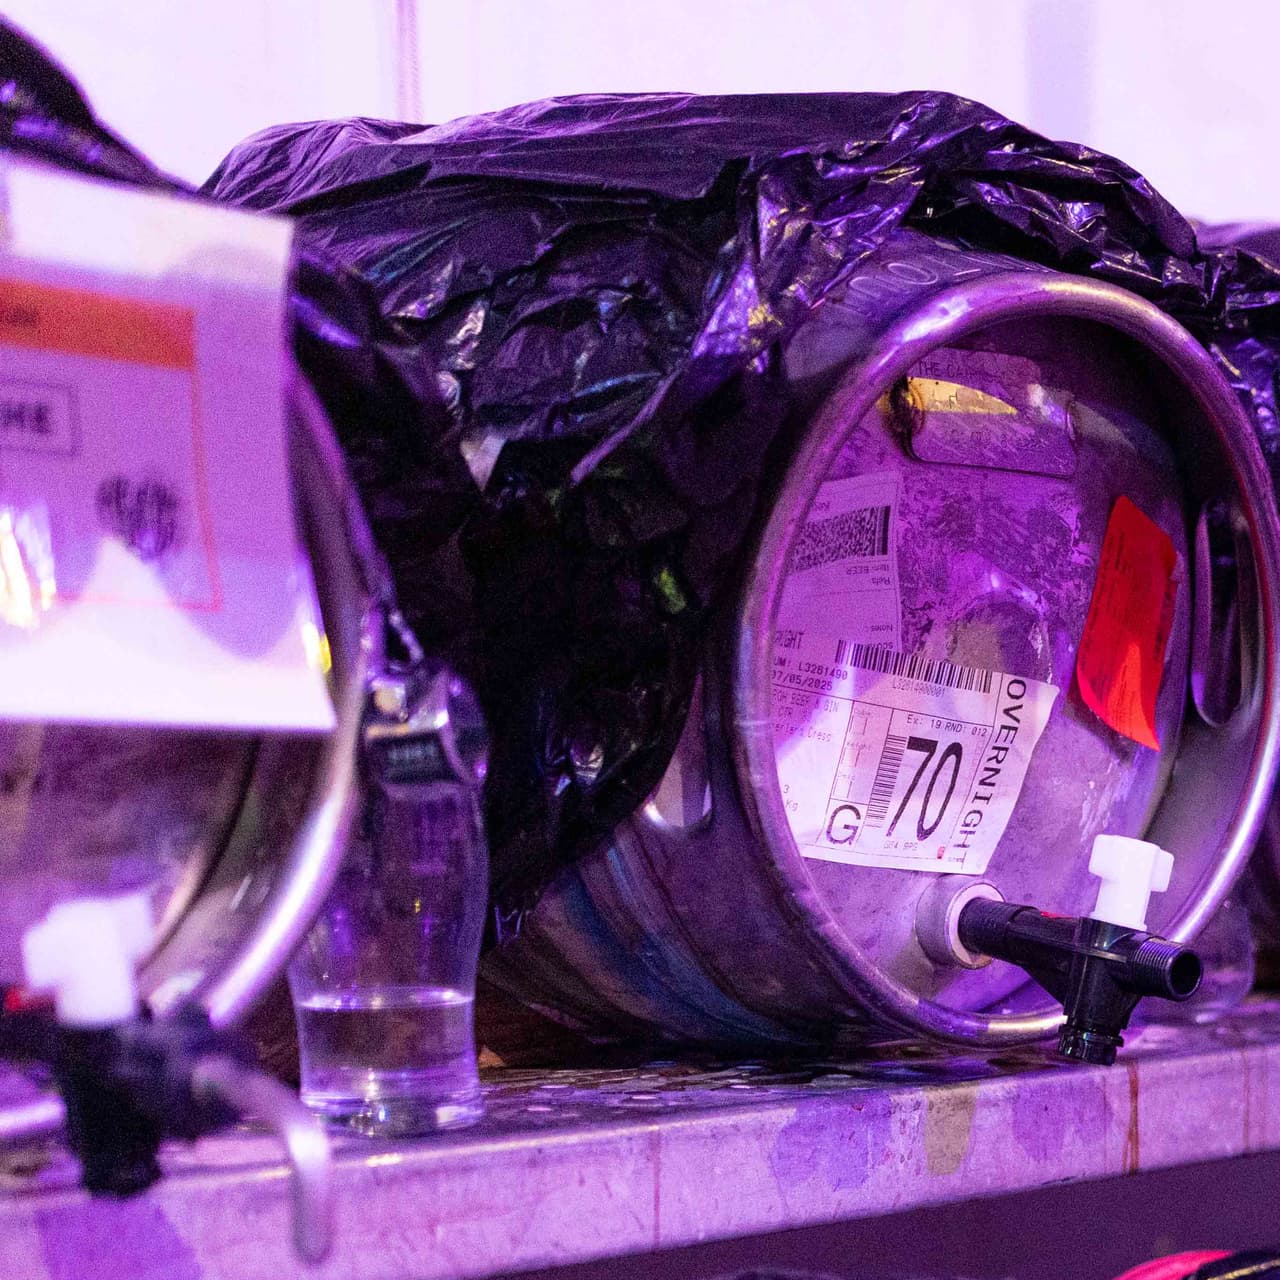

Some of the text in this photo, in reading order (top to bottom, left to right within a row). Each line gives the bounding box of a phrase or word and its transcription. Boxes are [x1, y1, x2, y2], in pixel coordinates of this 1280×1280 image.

[930, 718, 942, 730] 19
[886, 735, 963, 842] 70
[952, 678, 1027, 871] OVERNIGHT
[826, 804, 862, 846] G
